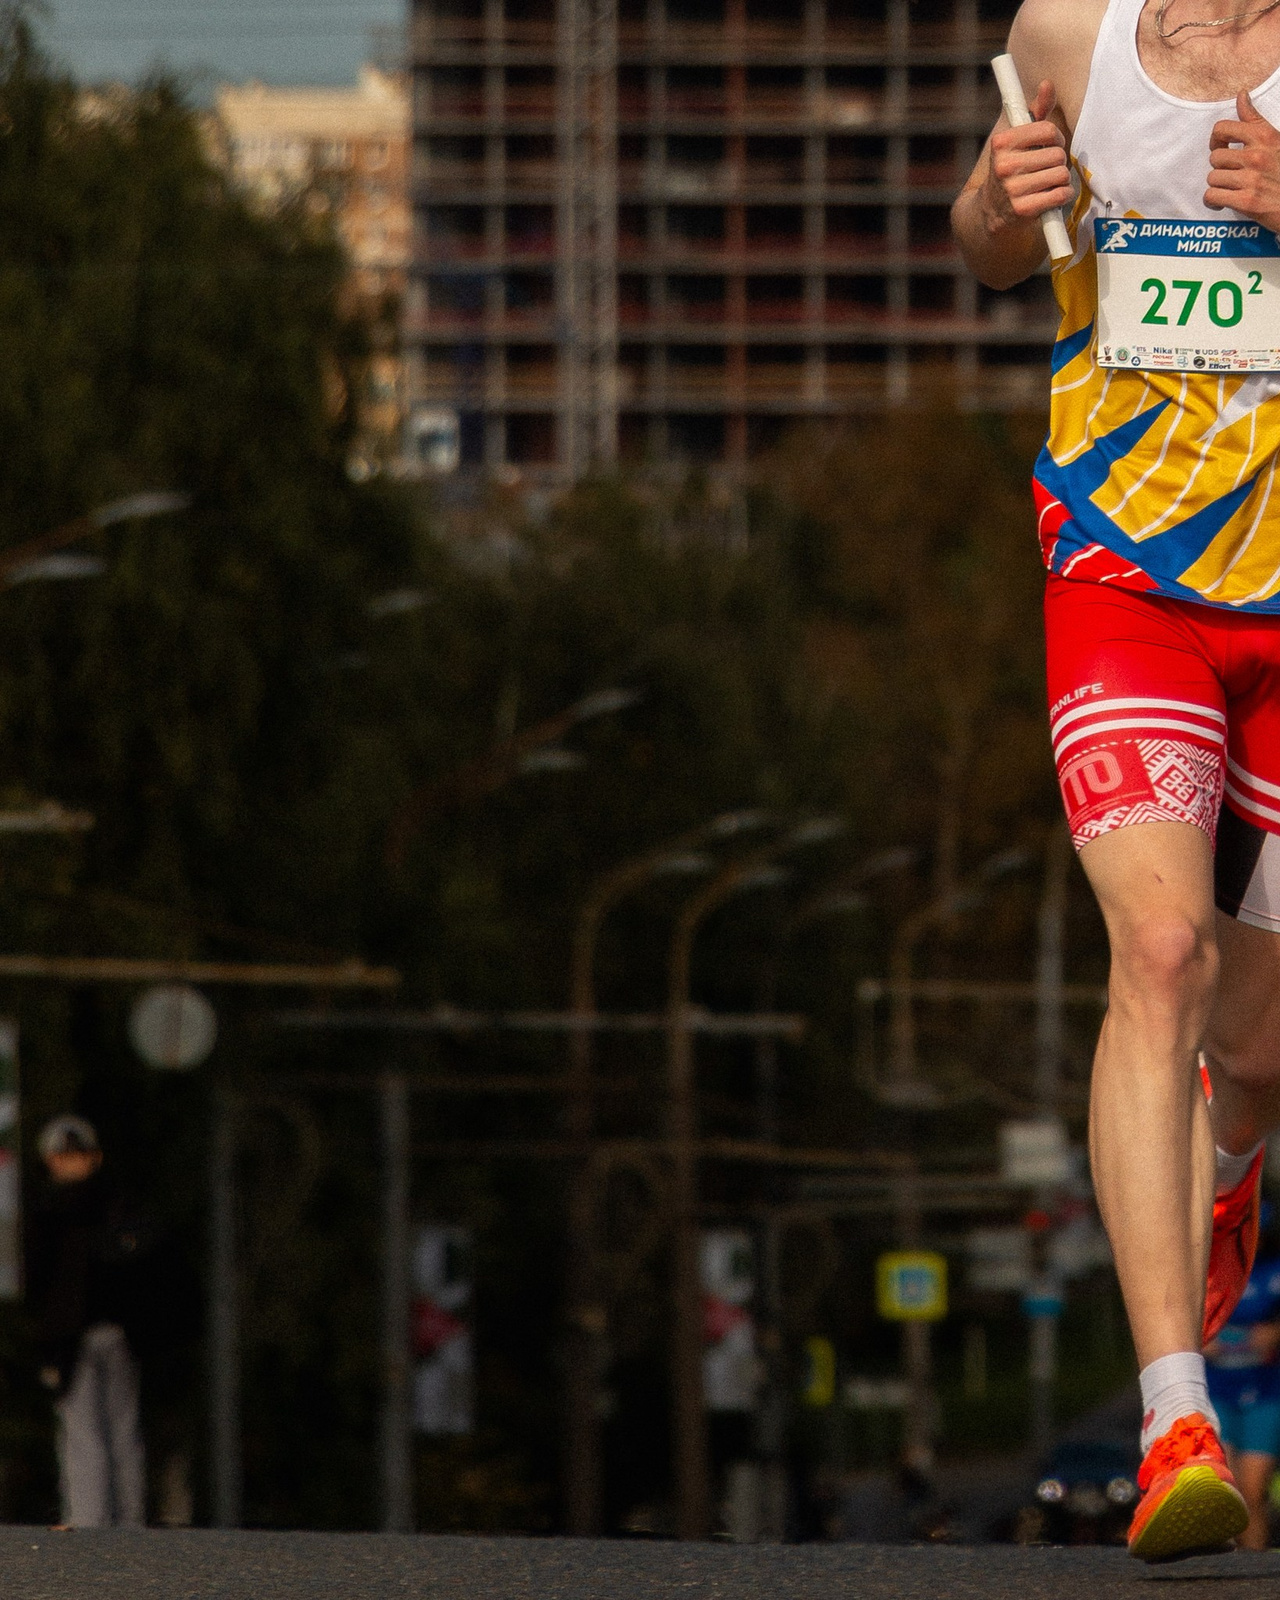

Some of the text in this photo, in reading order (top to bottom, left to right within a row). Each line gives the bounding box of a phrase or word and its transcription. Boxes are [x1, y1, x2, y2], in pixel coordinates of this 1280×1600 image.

[1140, 223, 1259, 239] ДИНАМОВСКАЯ
[1177, 240, 1222, 253] МИЛЯ
[1153, 346, 1172, 355] Nika
